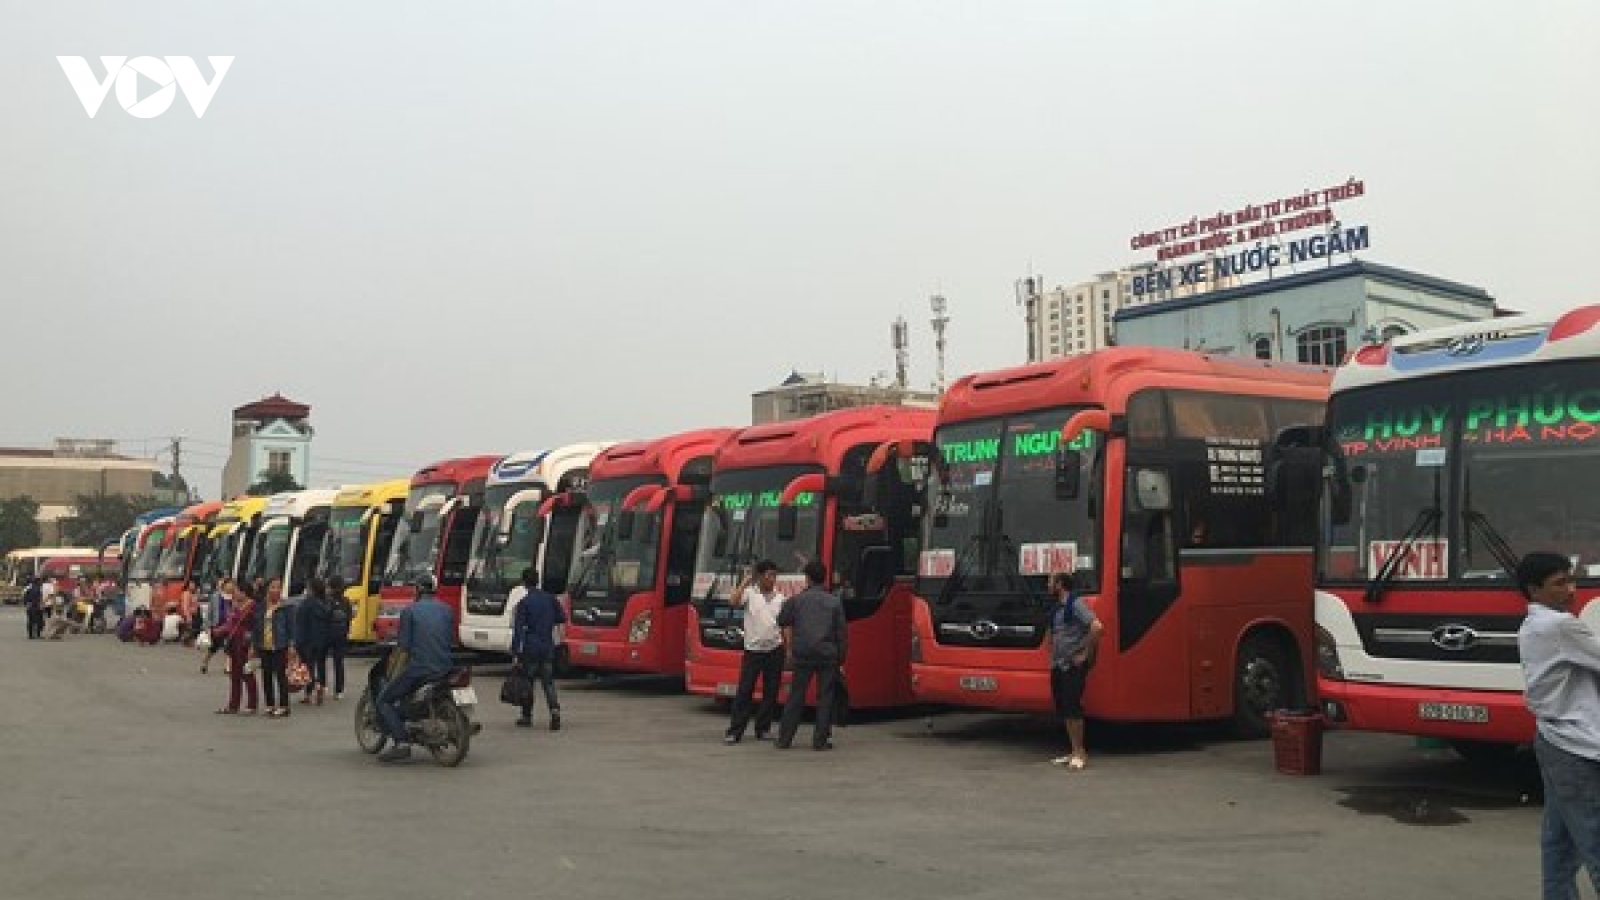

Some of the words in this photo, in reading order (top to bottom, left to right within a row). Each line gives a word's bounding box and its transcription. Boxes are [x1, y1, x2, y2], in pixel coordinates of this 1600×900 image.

[1285, 189, 1318, 213] PHÁT
[1132, 262, 1172, 297] BẾN
[1181, 260, 1206, 286] XE
[1214, 242, 1281, 278] NƯỚC
[1289, 220, 1369, 264] NGẦM
